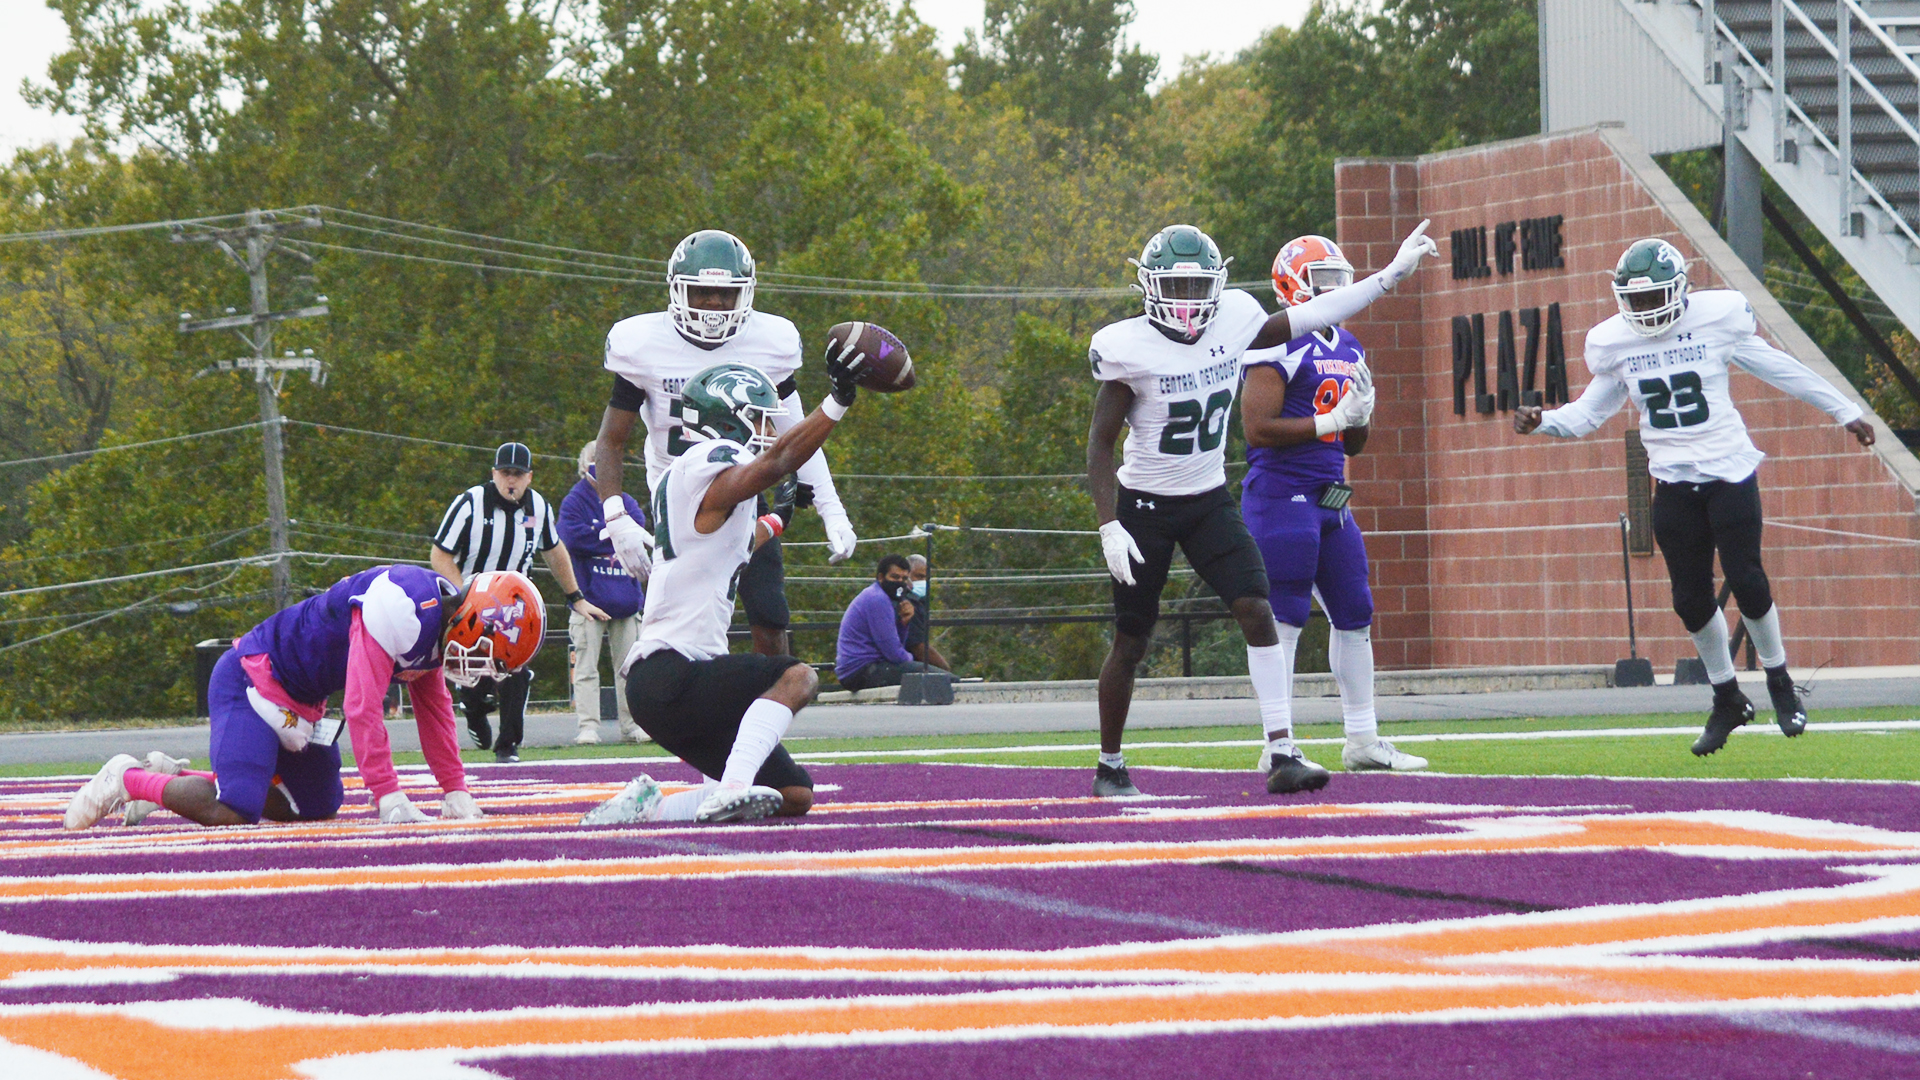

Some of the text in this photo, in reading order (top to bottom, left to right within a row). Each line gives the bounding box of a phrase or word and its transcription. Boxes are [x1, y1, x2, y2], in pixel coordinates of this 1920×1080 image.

[1495, 221, 1517, 276] OF
[1160, 371, 1198, 394] CENTRAL
[1451, 302, 1570, 416] PLAZA
[1627, 352, 1661, 373] CENTRAL
[1158, 388, 1232, 455] 20
[1638, 371, 1709, 429] 23
[593, 565, 627, 576] ALUMN
